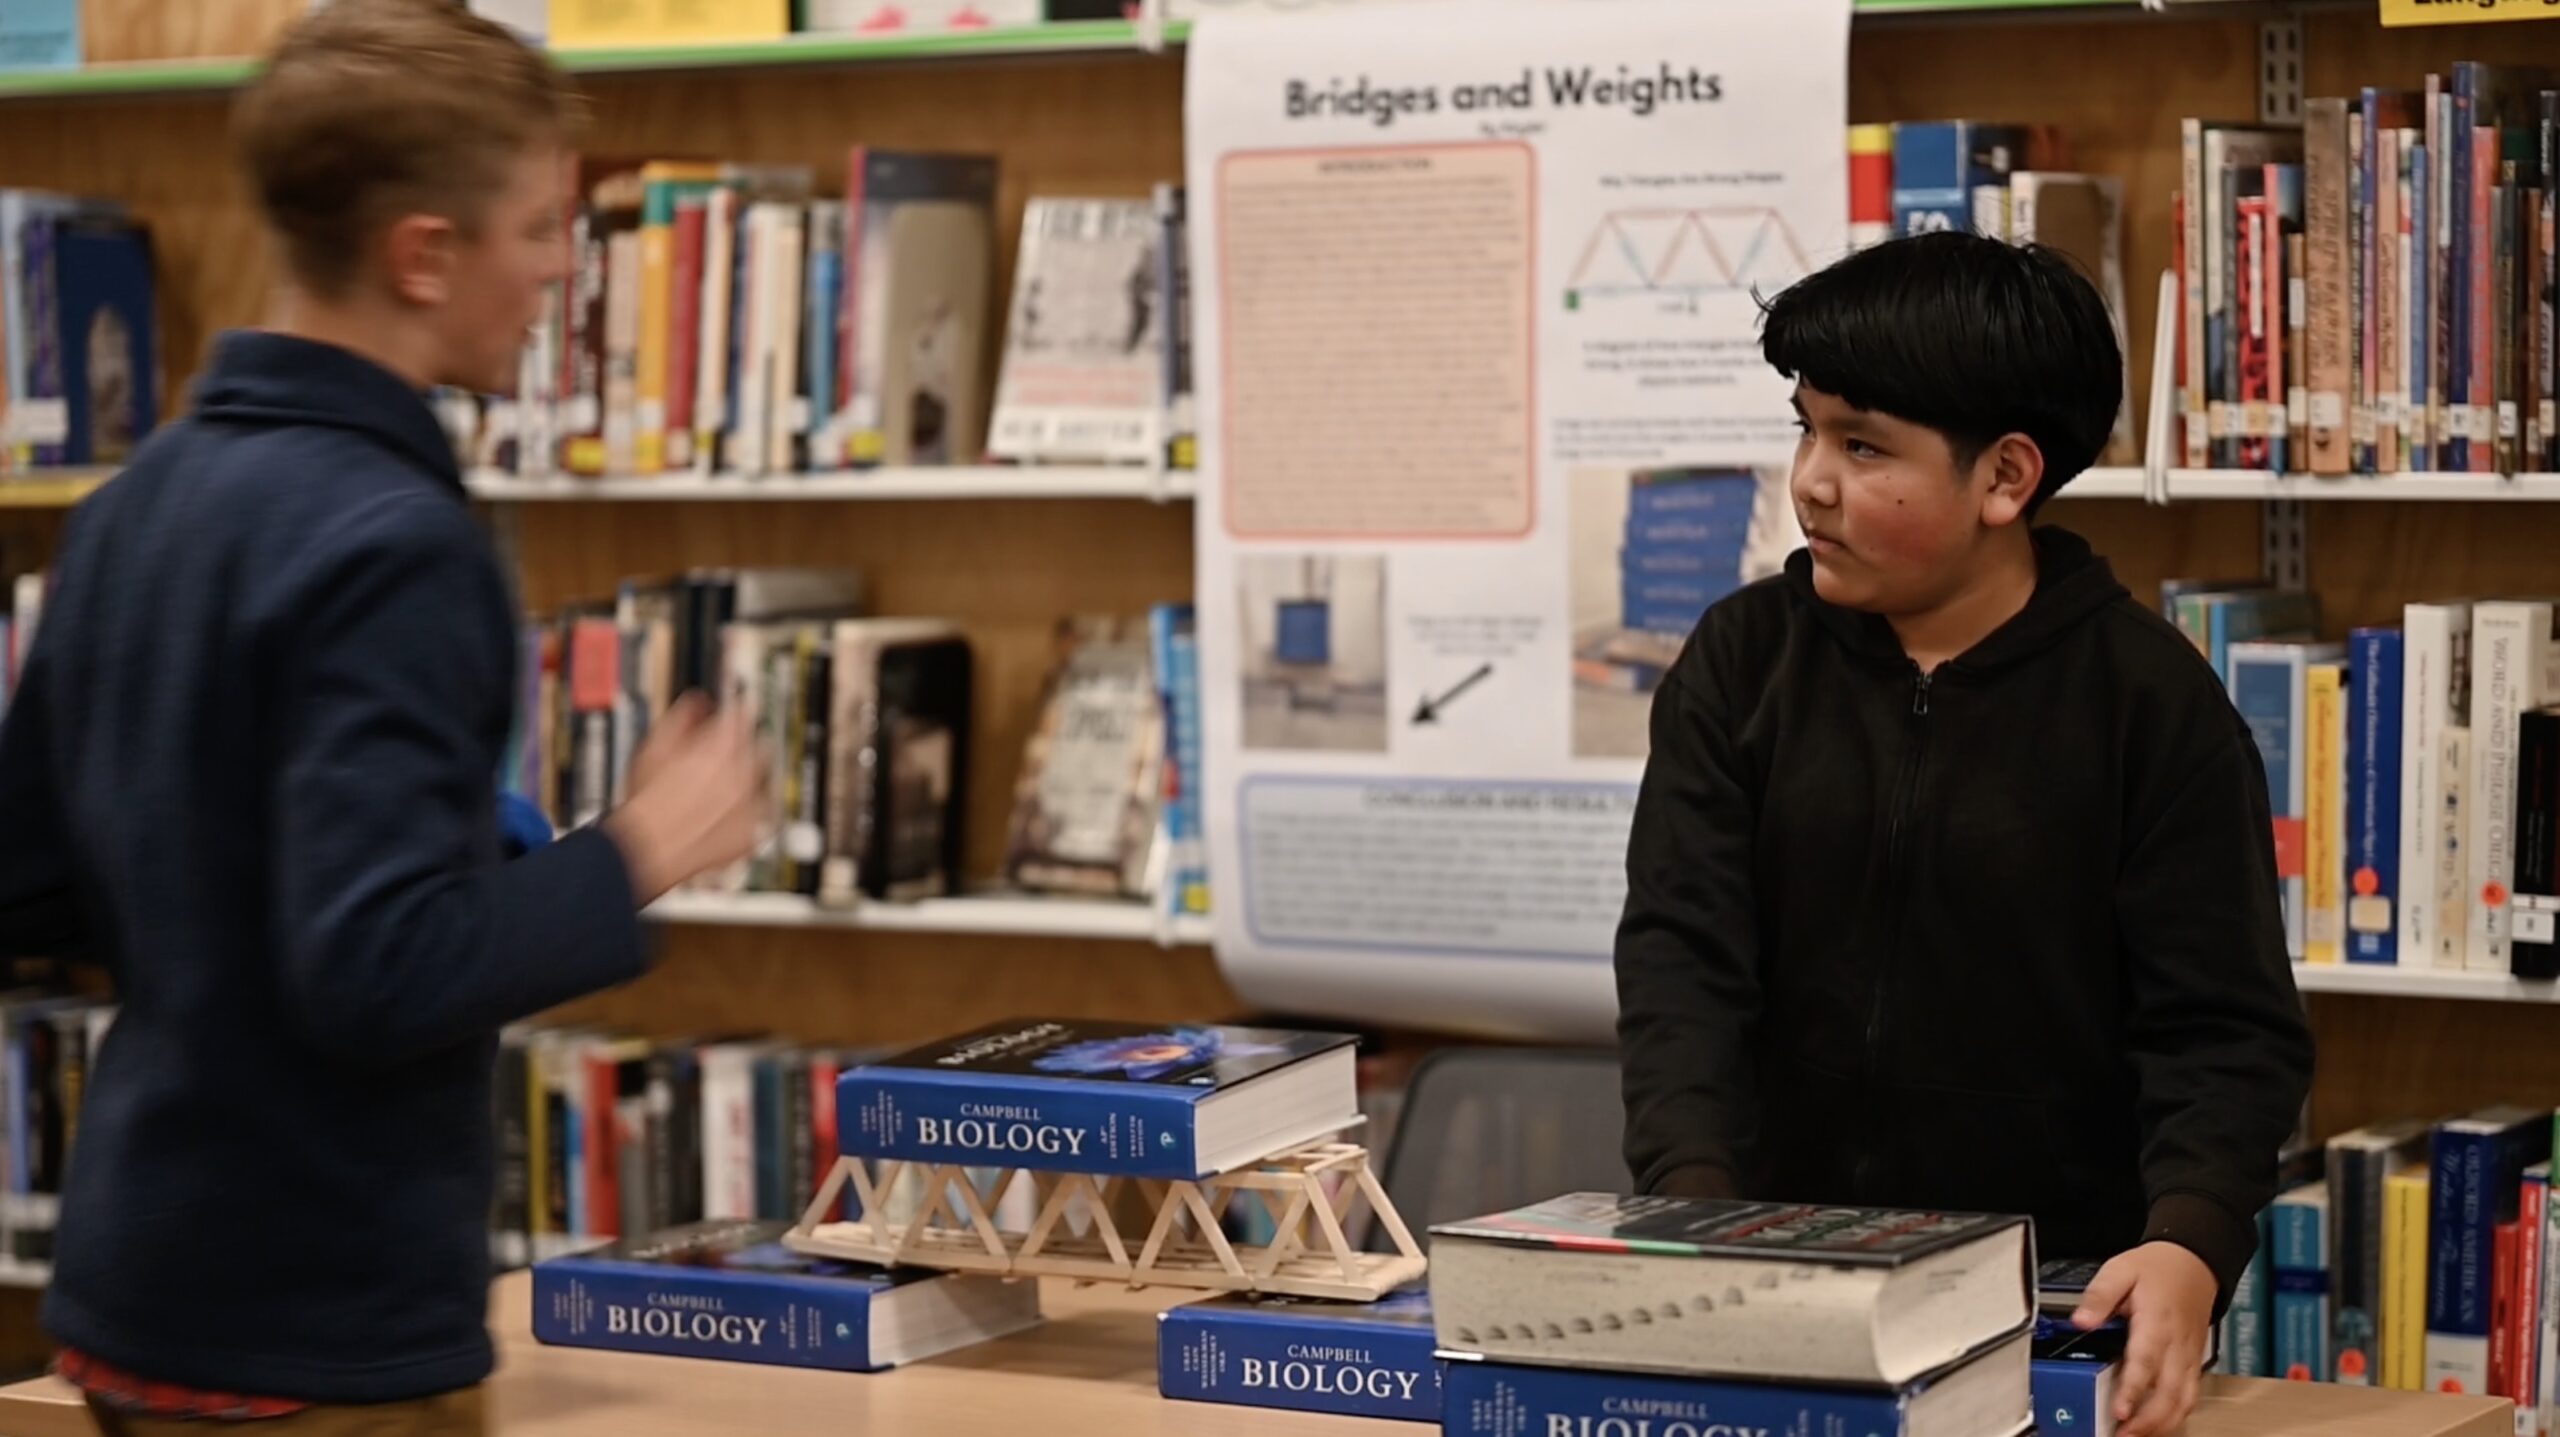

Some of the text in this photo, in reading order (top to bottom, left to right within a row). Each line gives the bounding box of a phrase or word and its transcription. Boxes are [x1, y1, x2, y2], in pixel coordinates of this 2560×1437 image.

[1284, 62, 1724, 127] Bridges and Weights
[960, 1103, 1042, 1122] CAMPBELL
[917, 1116, 1087, 1155] BIOLOGY
[1109, 1112, 1117, 1158] EDITION
[647, 1293, 725, 1312] CAMPBELL
[607, 1305, 768, 1345] BIOLOGY
[1201, 1329, 1209, 1389] WASSERMAN
[1287, 1344, 1373, 1364] CAMPBELL
[1242, 1358, 1420, 1400] BIOLOGY
[1602, 1396, 1708, 1420] CAMPBELL
